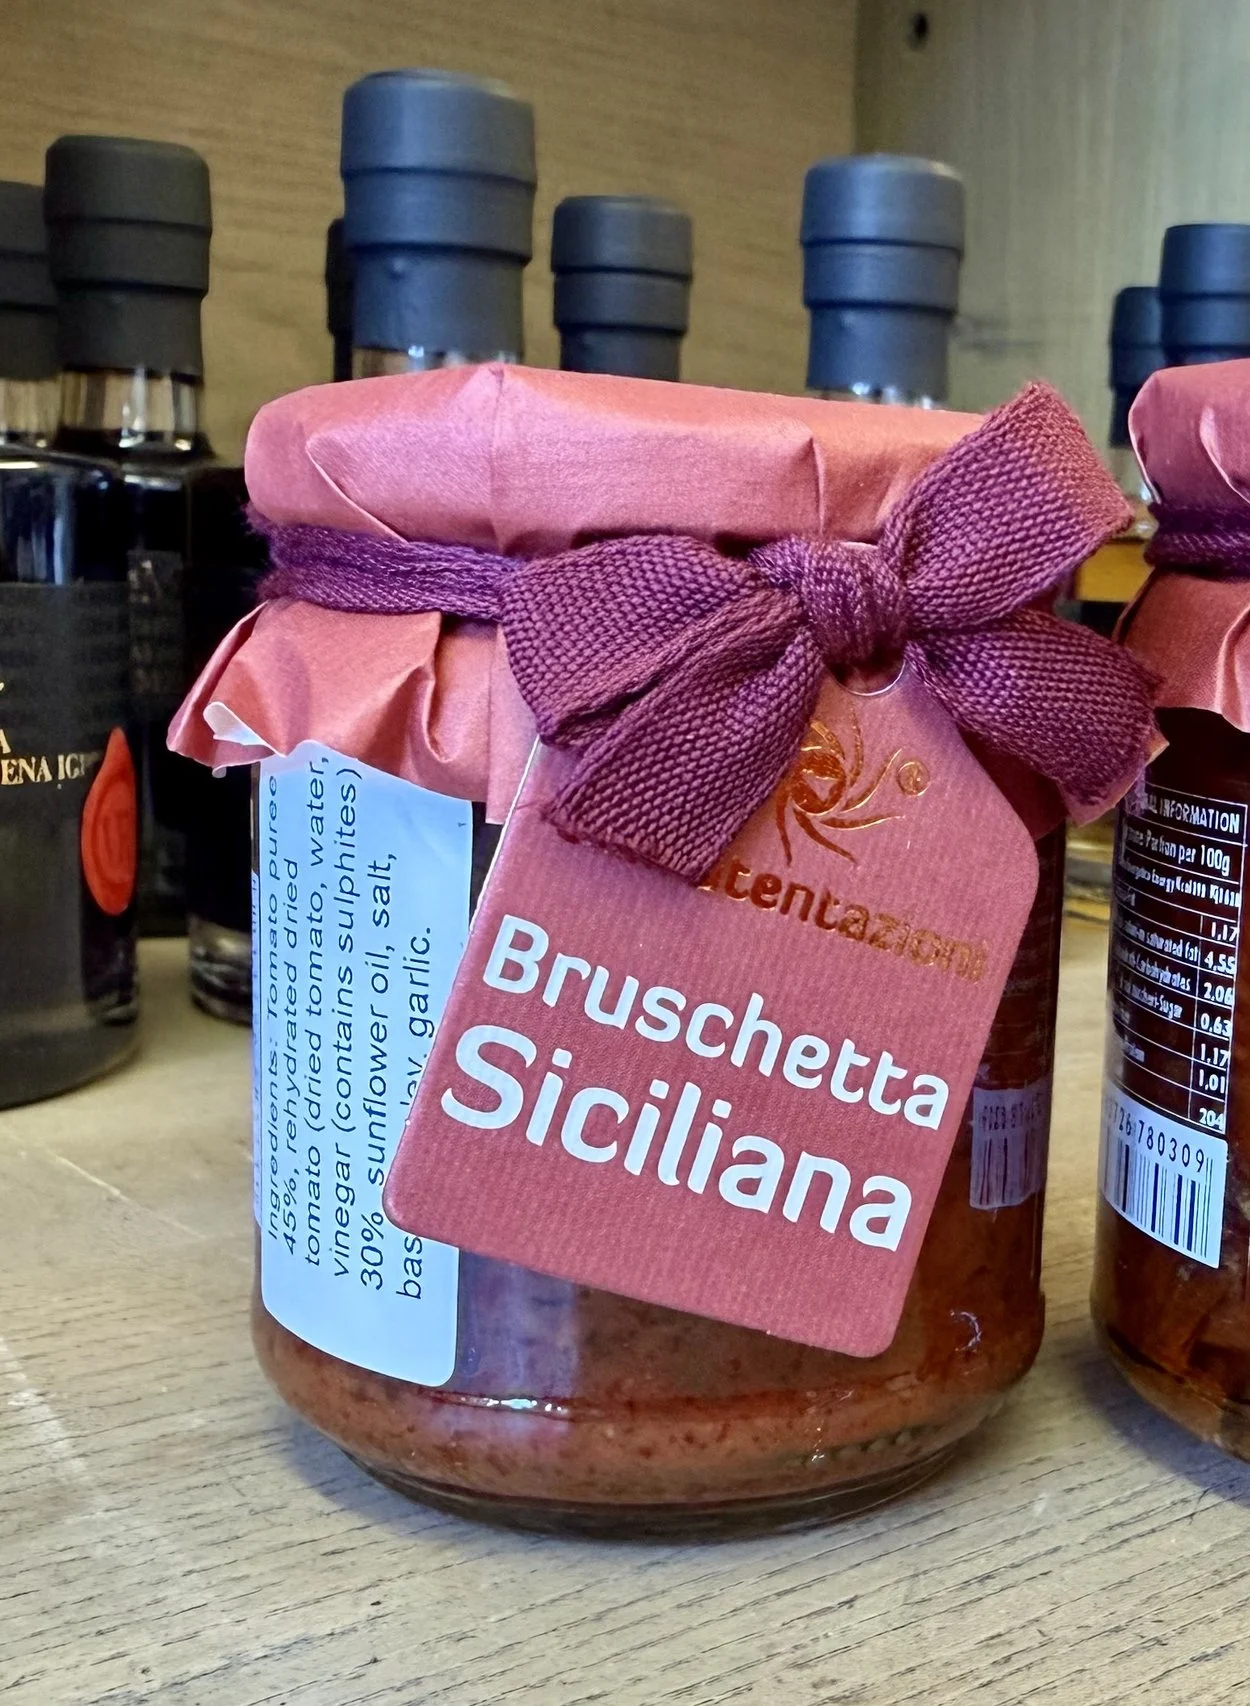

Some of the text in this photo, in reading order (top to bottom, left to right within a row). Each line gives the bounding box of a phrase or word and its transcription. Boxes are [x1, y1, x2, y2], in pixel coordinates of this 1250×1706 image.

[269, 775, 280, 881] puree
[1160, 797, 1241, 835] INFORMATION
[1178, 844, 1197, 865] per
[1200, 844, 1231, 877] 100g
[267, 893, 278, 1021] Tomato
[402, 926, 435, 1039] garlic.
[698, 856, 990, 985] tentazioni
[282, 858, 301, 1256] 45%, rehydrated dried
[303, 756, 329, 1267] tomato (dried tomato, water,
[328, 767, 363, 1278] vinegar (contains sulphites)
[360, 852, 397, 1291] 30% sunflower oil, salt,
[482, 912, 952, 1132] Bruschetta
[440, 1023, 914, 1253] Siciliana
[1137, 1119, 1205, 1173] 780309
